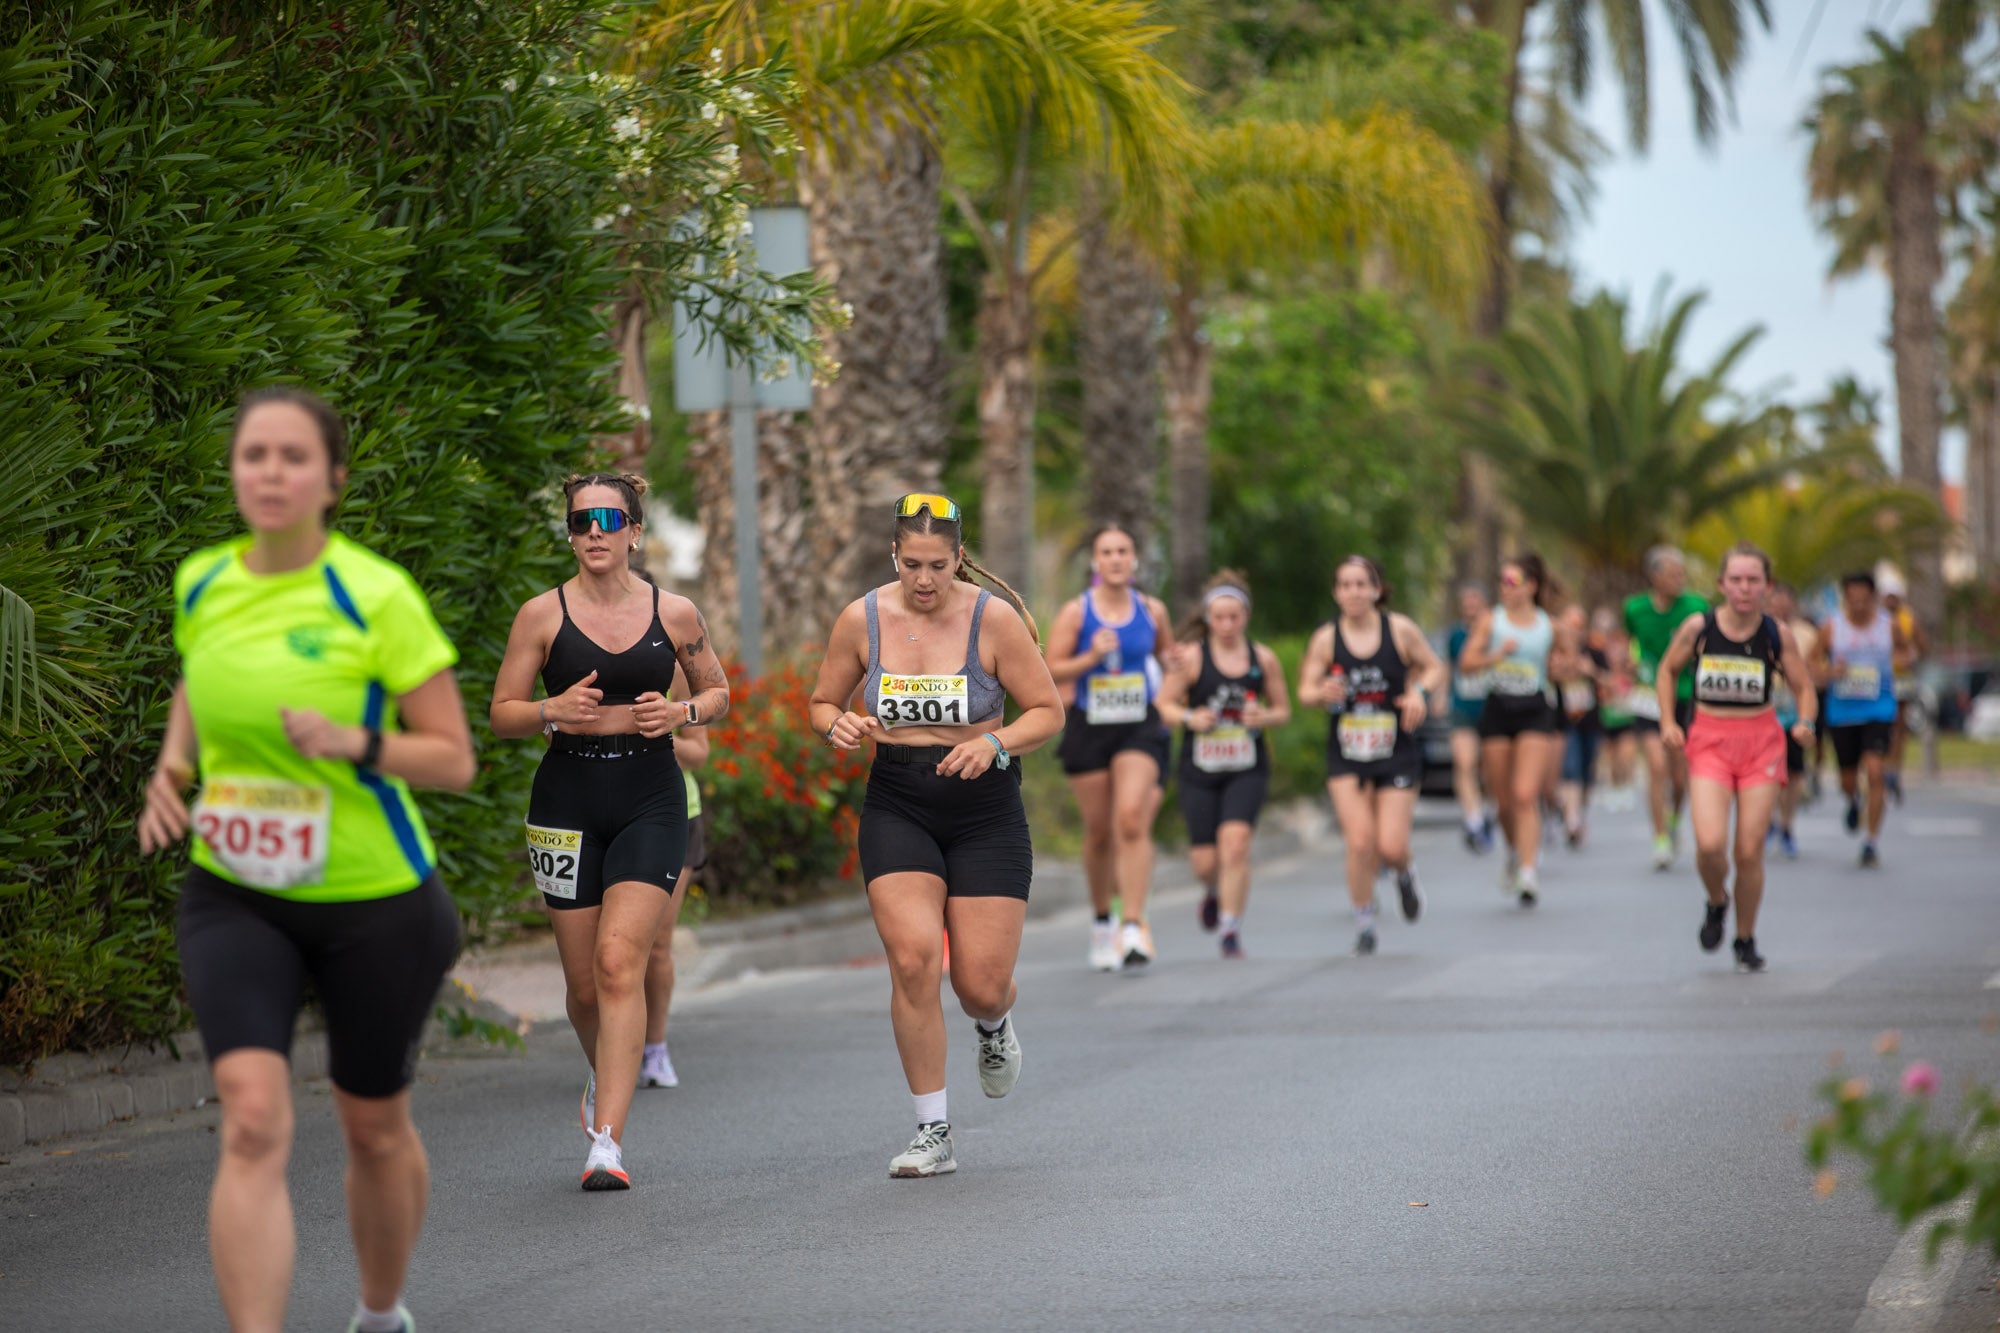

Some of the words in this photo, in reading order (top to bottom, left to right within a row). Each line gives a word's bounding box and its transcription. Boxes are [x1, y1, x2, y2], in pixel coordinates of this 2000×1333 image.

[904, 683, 948, 692] FONDO
[1702, 675, 1760, 693] 4016
[881, 699, 961, 723] 3301
[198, 812, 314, 861] 2051
[530, 847, 575, 880] 302
